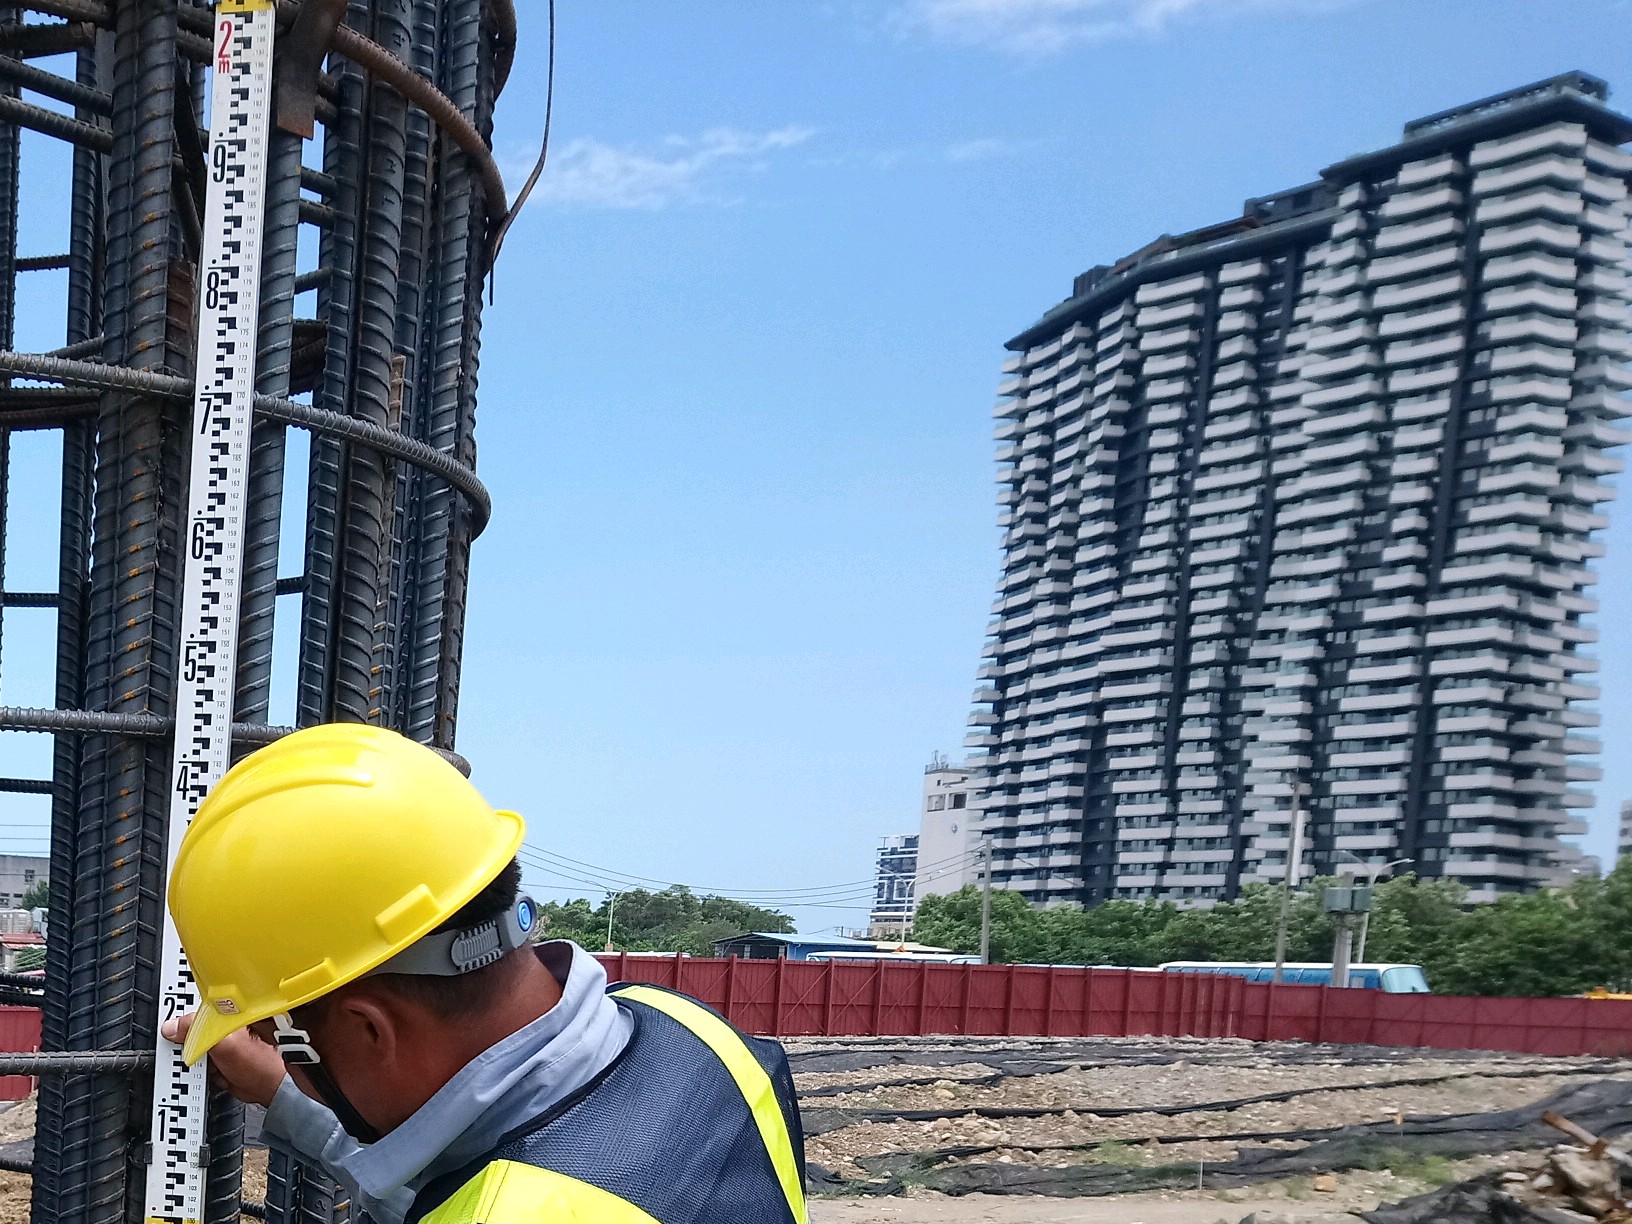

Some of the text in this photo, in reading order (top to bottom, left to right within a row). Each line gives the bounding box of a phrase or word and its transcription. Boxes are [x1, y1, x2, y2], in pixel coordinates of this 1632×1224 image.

[218, 20, 232, 59] 2
[212, 144, 226, 183] 9
[206, 271, 219, 310] 8
[199, 397, 212, 435] 7
[191, 521, 204, 560] 6
[183, 644, 197, 682] 5
[176, 765, 189, 802] 4
[157, 1108, 166, 1142] 1
